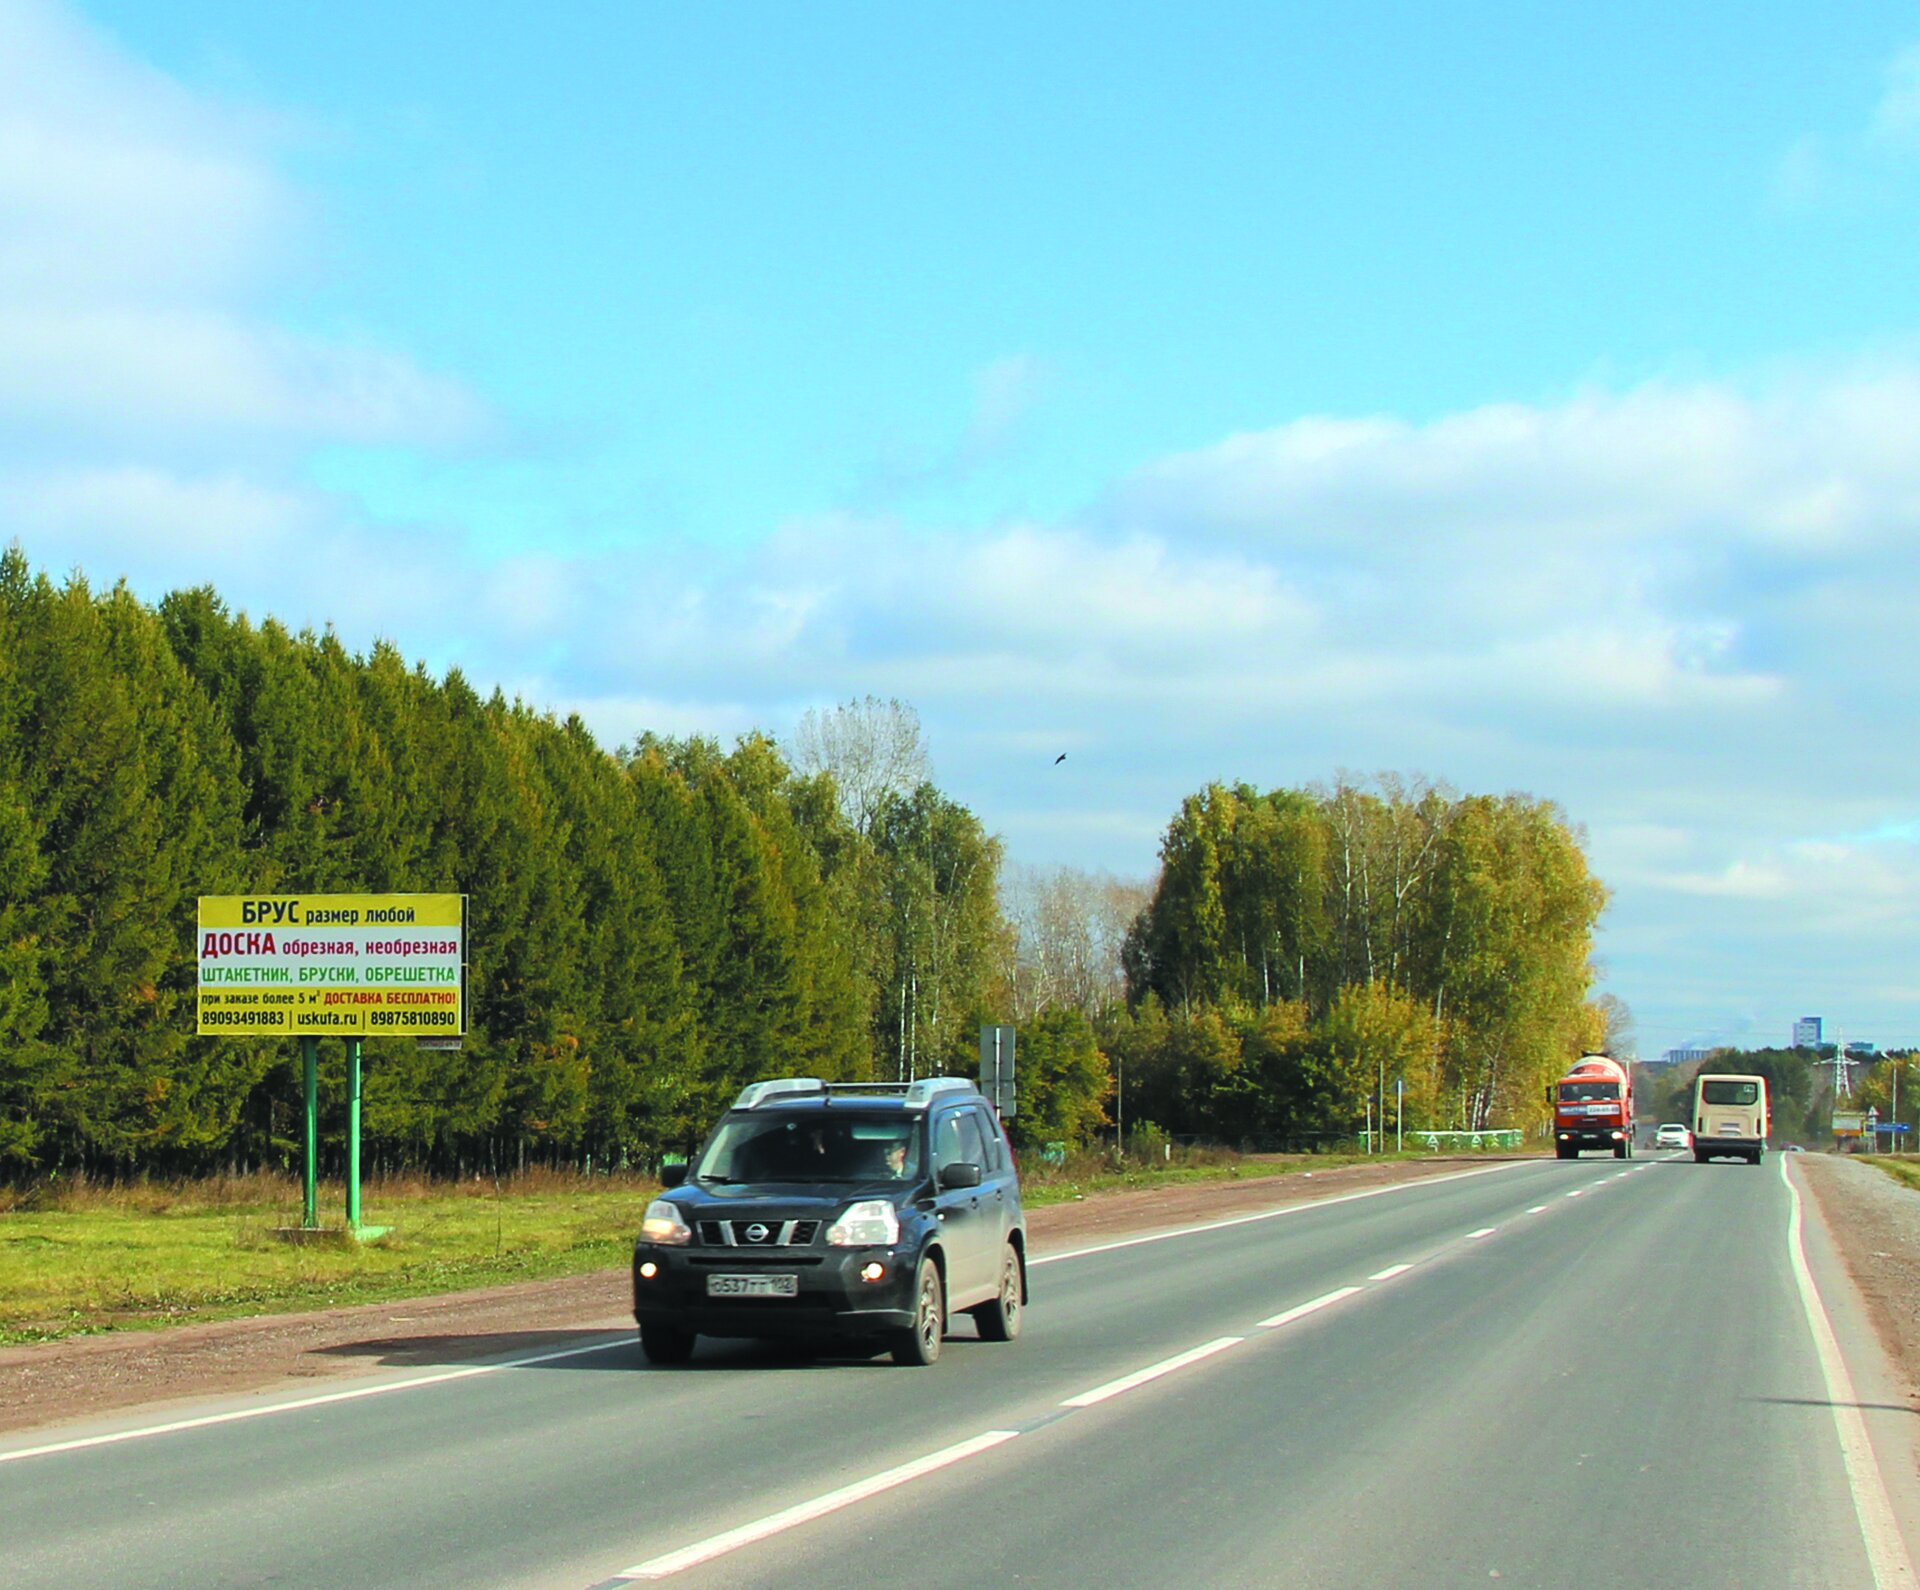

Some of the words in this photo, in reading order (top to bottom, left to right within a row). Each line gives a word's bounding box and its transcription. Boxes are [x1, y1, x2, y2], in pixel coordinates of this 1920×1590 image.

[242, 901, 299, 923] БРУС
[306, 910, 358, 925] размер
[365, 907, 415, 922] любой
[202, 932, 276, 958] ДОСКА
[283, 939, 359, 956] обрезная,
[366, 939, 457, 956] необрезная
[202, 967, 293, 983] ШТАКЕТНИК,
[299, 967, 359, 983] БРУСКИ,
[365, 967, 455, 981] ОБРЕШЕТКА
[202, 994, 220, 1005] при
[224, 994, 259, 1004] заказе
[262, 992, 294, 1004] более
[298, 993, 305, 1004] 5
[324, 992, 382, 1005] ДОСТАВКА
[386, 992, 456, 1004] БЕСПЛАТНО!
[202, 1011, 284, 1025] 89093491883
[297, 1011, 357, 1025] uskufa.ru
[371, 1011, 455, 1025] 89875810890
